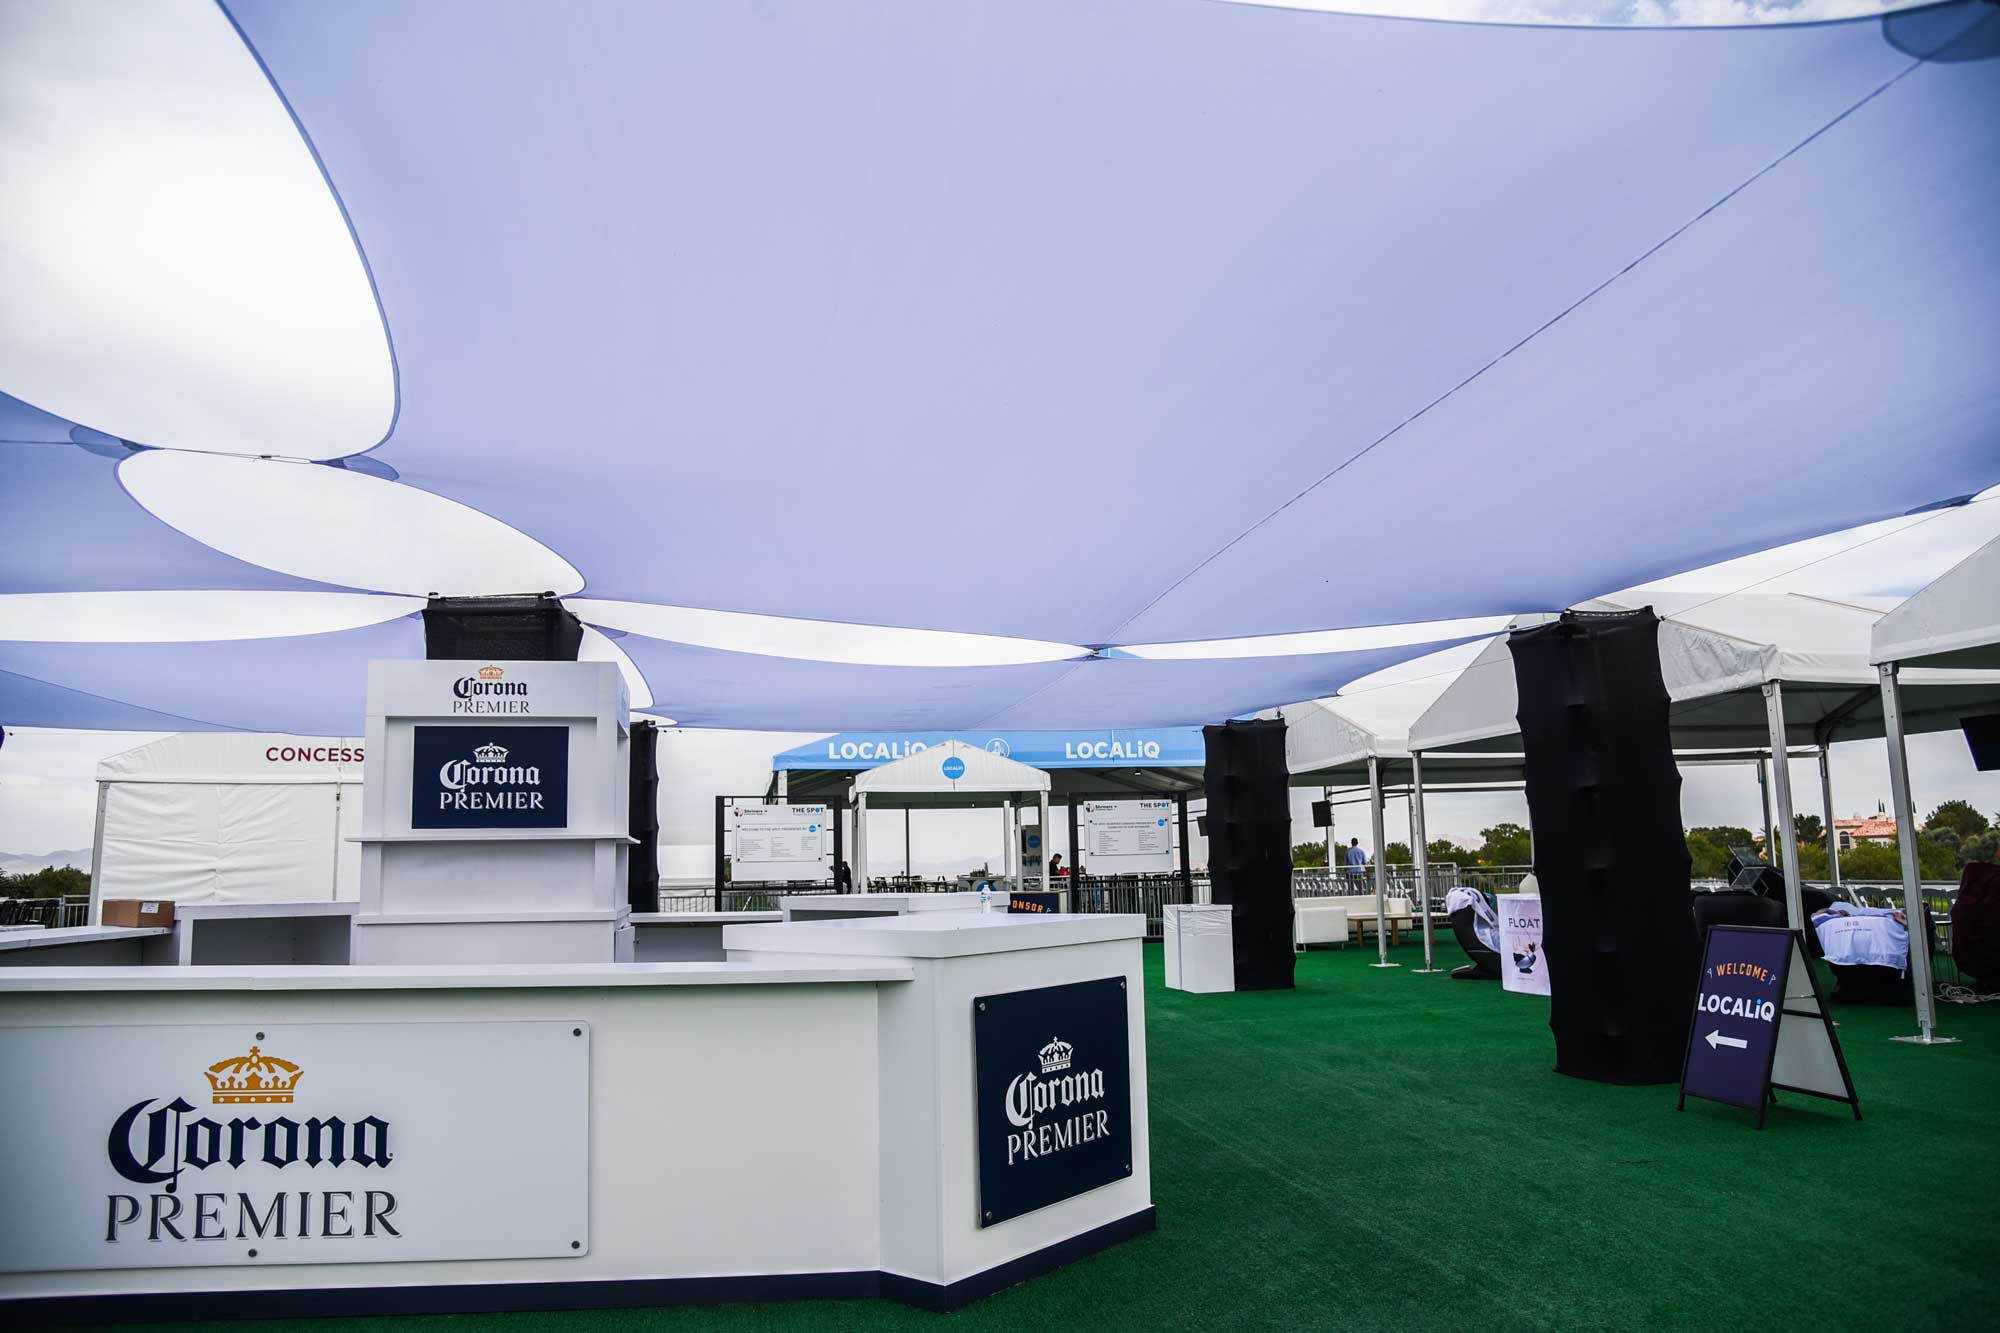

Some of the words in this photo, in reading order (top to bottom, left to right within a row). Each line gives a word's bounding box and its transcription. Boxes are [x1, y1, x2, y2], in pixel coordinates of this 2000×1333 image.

[453, 676, 528, 701] Corona
[453, 701, 531, 713] PREMIER
[265, 747, 365, 762] CONCESS
[1065, 740, 1160, 759] LOCALiQ
[440, 759, 541, 792] Corona
[440, 792, 545, 810] PREMIER
[1508, 917, 1541, 929] FLOAT
[1716, 962, 1769, 982] WELCOME
[1698, 993, 1775, 1022] LOCALiQ
[1005, 1068, 1105, 1129] Corona
[107, 1096, 393, 1193] Corona
[1007, 1109, 1111, 1166] PREMIER
[104, 1190, 402, 1242] PREMIER
